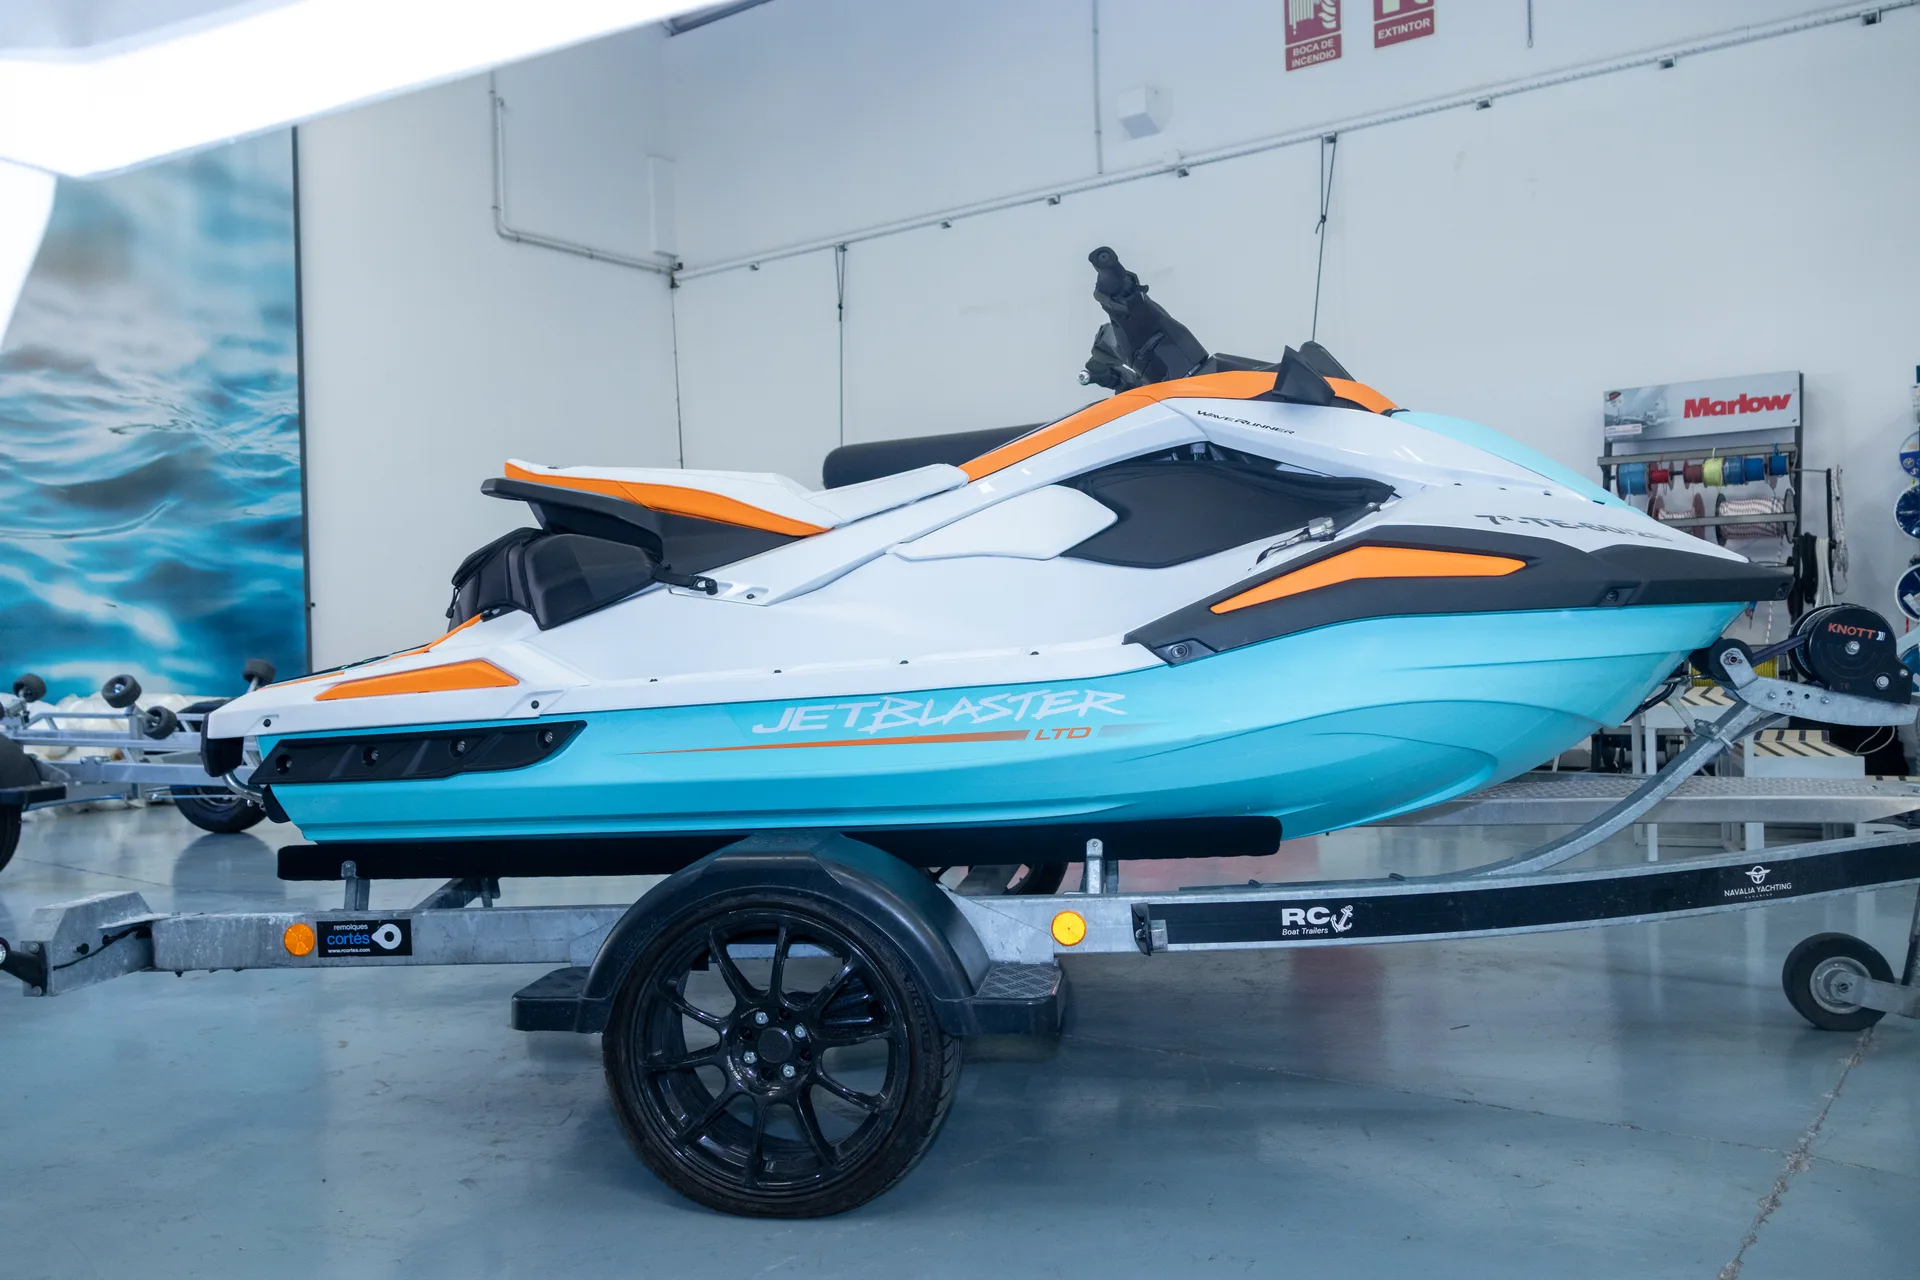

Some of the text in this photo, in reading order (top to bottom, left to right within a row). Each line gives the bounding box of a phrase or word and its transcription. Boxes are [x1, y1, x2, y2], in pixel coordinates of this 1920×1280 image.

[1378, 18, 1431, 40] EXTINTOR
[1293, 38, 1334, 57] BOCA DE
[1291, 49, 1336, 68] INCENDIO
[1684, 393, 1792, 419] Marlow
[1828, 623, 1876, 639] KNOTT
[752, 689, 1128, 735] JETBLASTER
[1034, 727, 1092, 740] LTD
[1724, 887, 1755, 897] NAVALIA
[1756, 883, 1792, 894] YACHTING
[1281, 906, 1331, 926] RC
[327, 932, 370, 945] cortés
[1282, 927, 1329, 936] Boat Trailers
